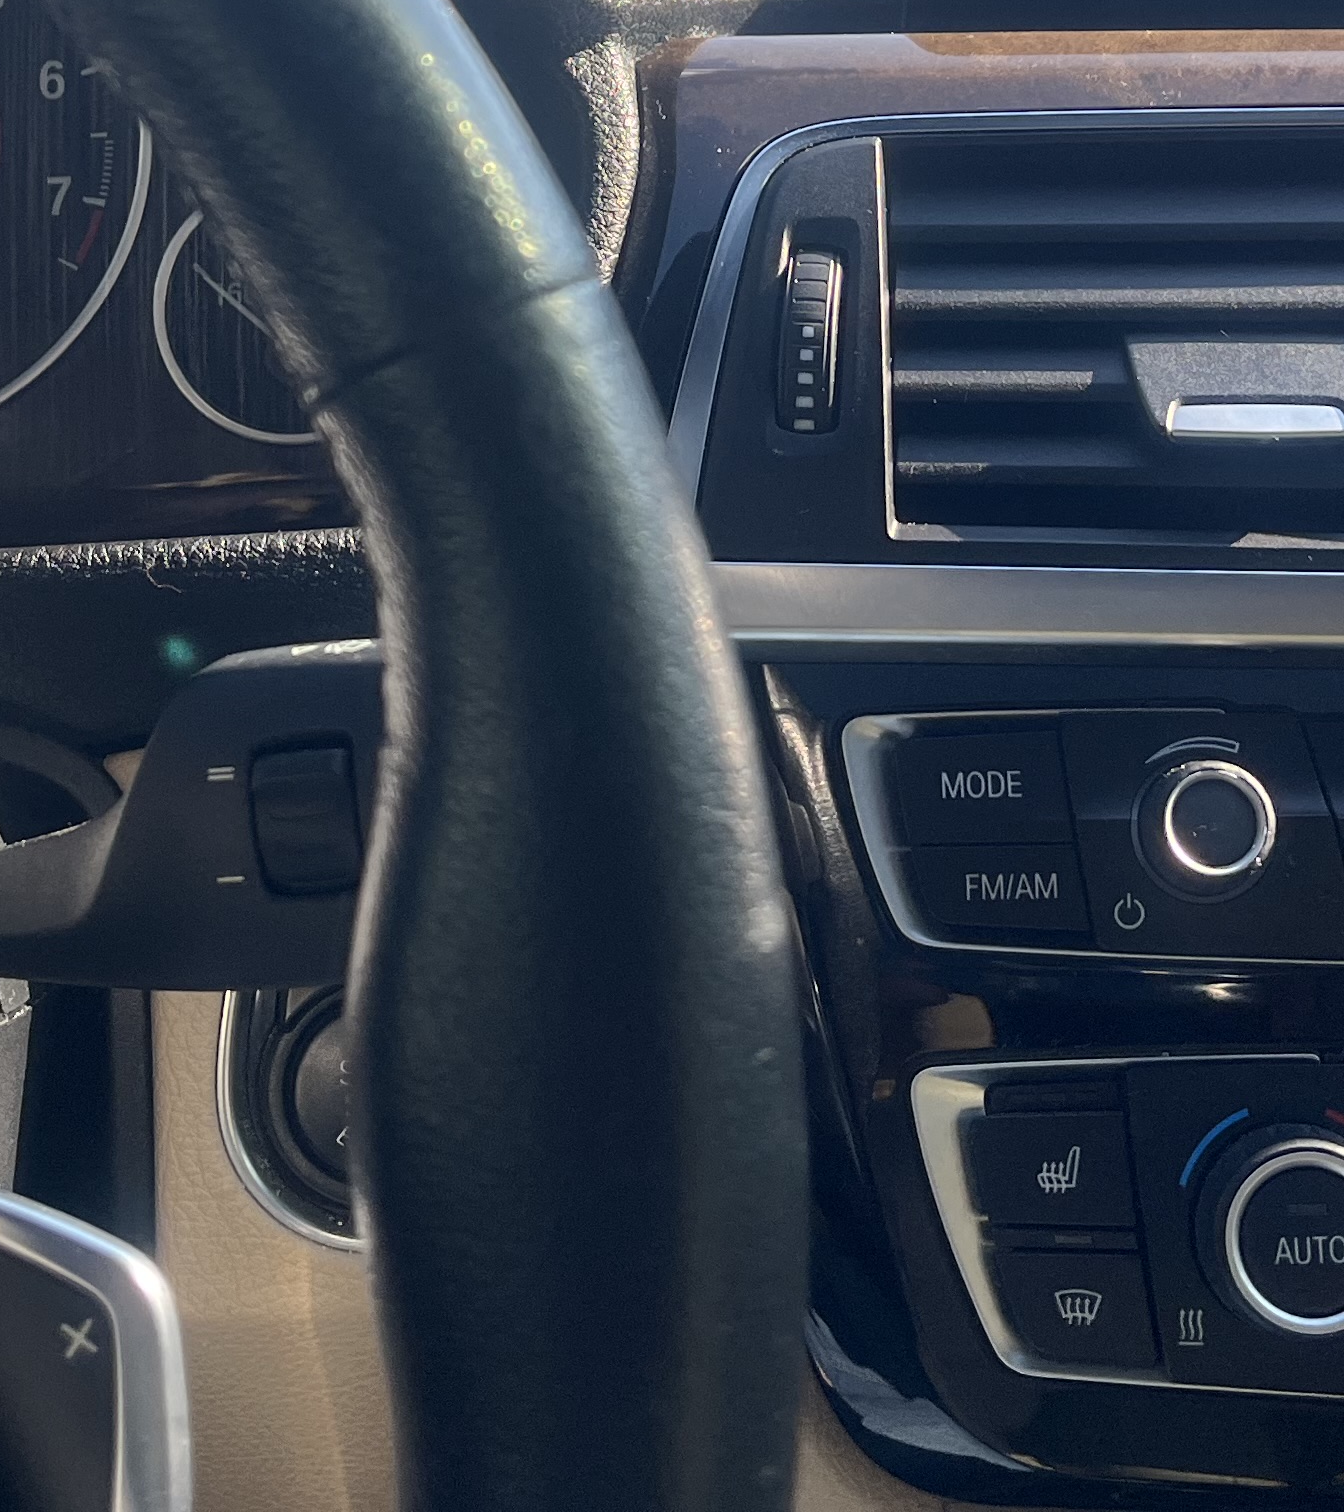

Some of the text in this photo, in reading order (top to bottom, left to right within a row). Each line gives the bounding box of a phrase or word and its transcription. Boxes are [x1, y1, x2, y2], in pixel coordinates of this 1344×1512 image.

[40, 61, 64, 99] 6
[47, 176, 71, 215] 7
[942, 771, 1022, 798] MODE
[966, 873, 1057, 900] FM/AM
